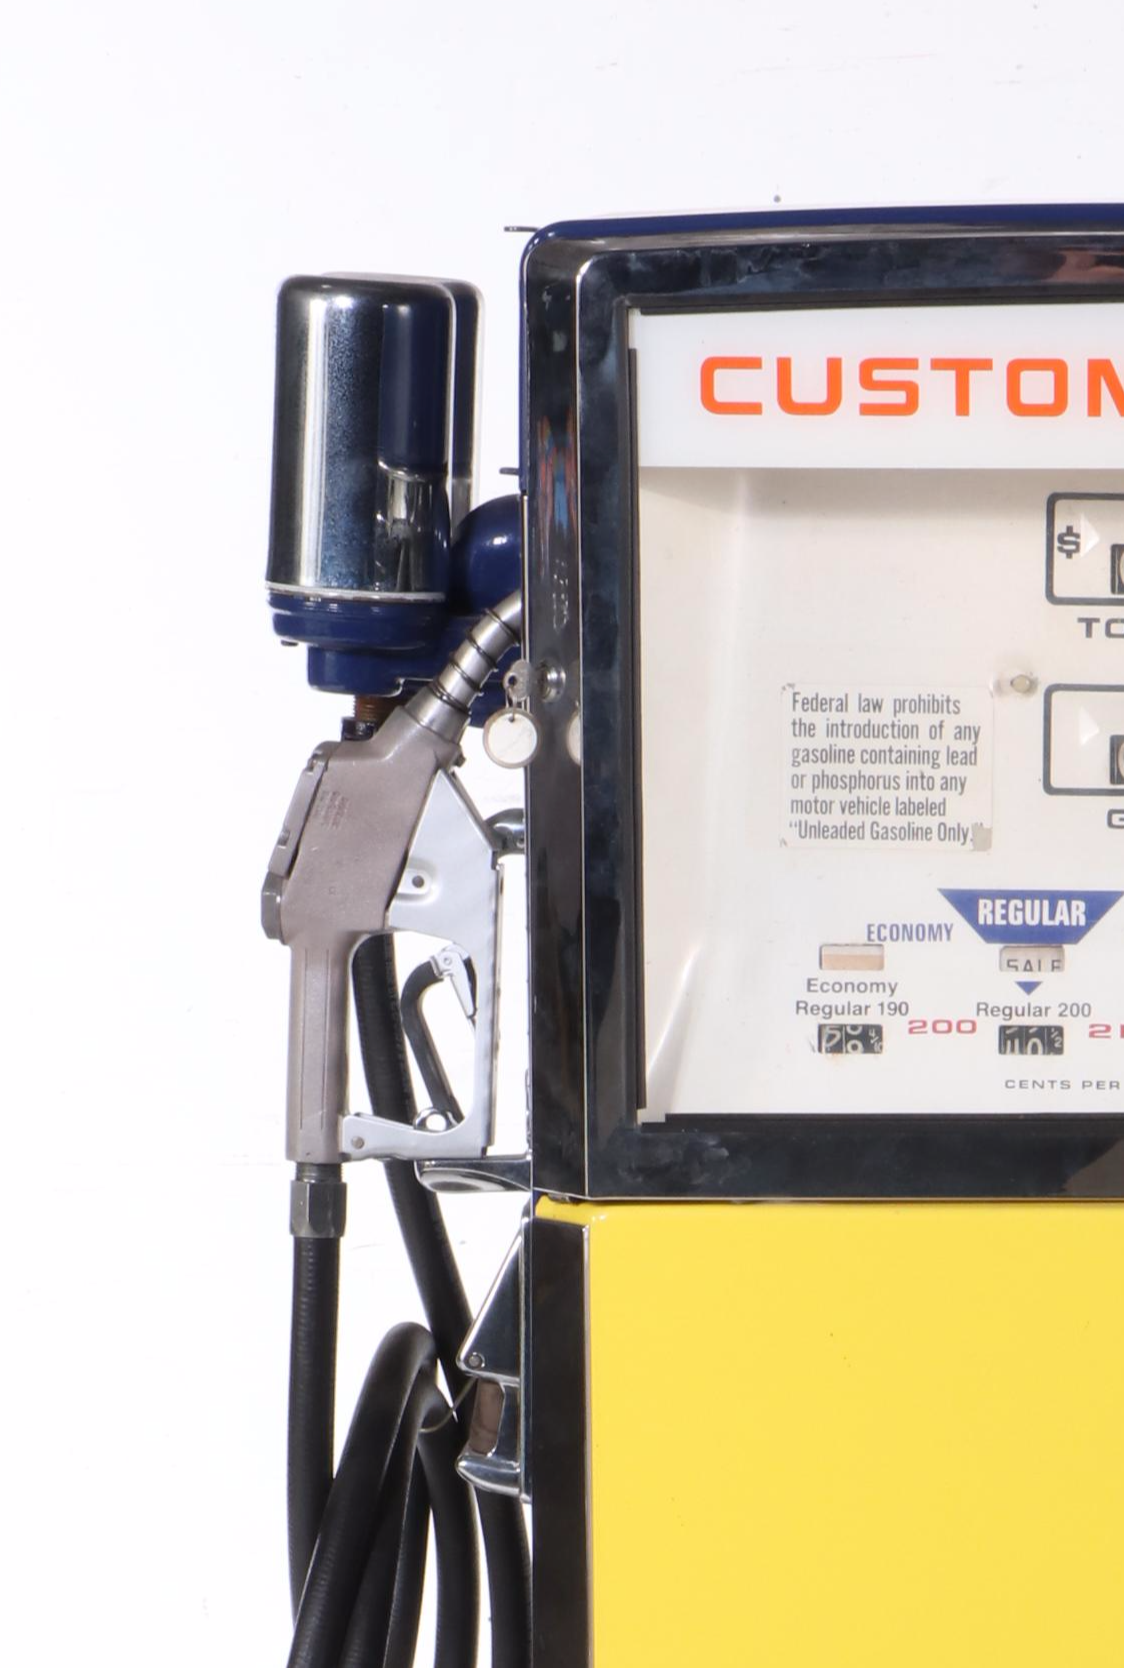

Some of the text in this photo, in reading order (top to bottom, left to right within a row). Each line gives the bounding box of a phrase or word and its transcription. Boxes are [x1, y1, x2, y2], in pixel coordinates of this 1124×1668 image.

[793, 692, 960, 718] Federal law prohibits
[791, 717, 980, 746] the introduction of any
[792, 744, 977, 769] gasoline containing lead
[791, 769, 967, 796] or phosphorus into any
[791, 796, 946, 816] motor vehicle labeled
[870, 821, 933, 841] Gasoline
[977, 897, 1087, 928] REGULAR
[866, 923, 954, 943] ECONOMY
[807, 978, 898, 997] Economy
[796, 1000, 909, 1020] Regular 190
[974, 1002, 1091, 1021] Regular 200
[908, 1020, 977, 1034] 200
[1005, 1080, 1071, 1089] CENTS
[1082, 1081, 1120, 1090] PER
